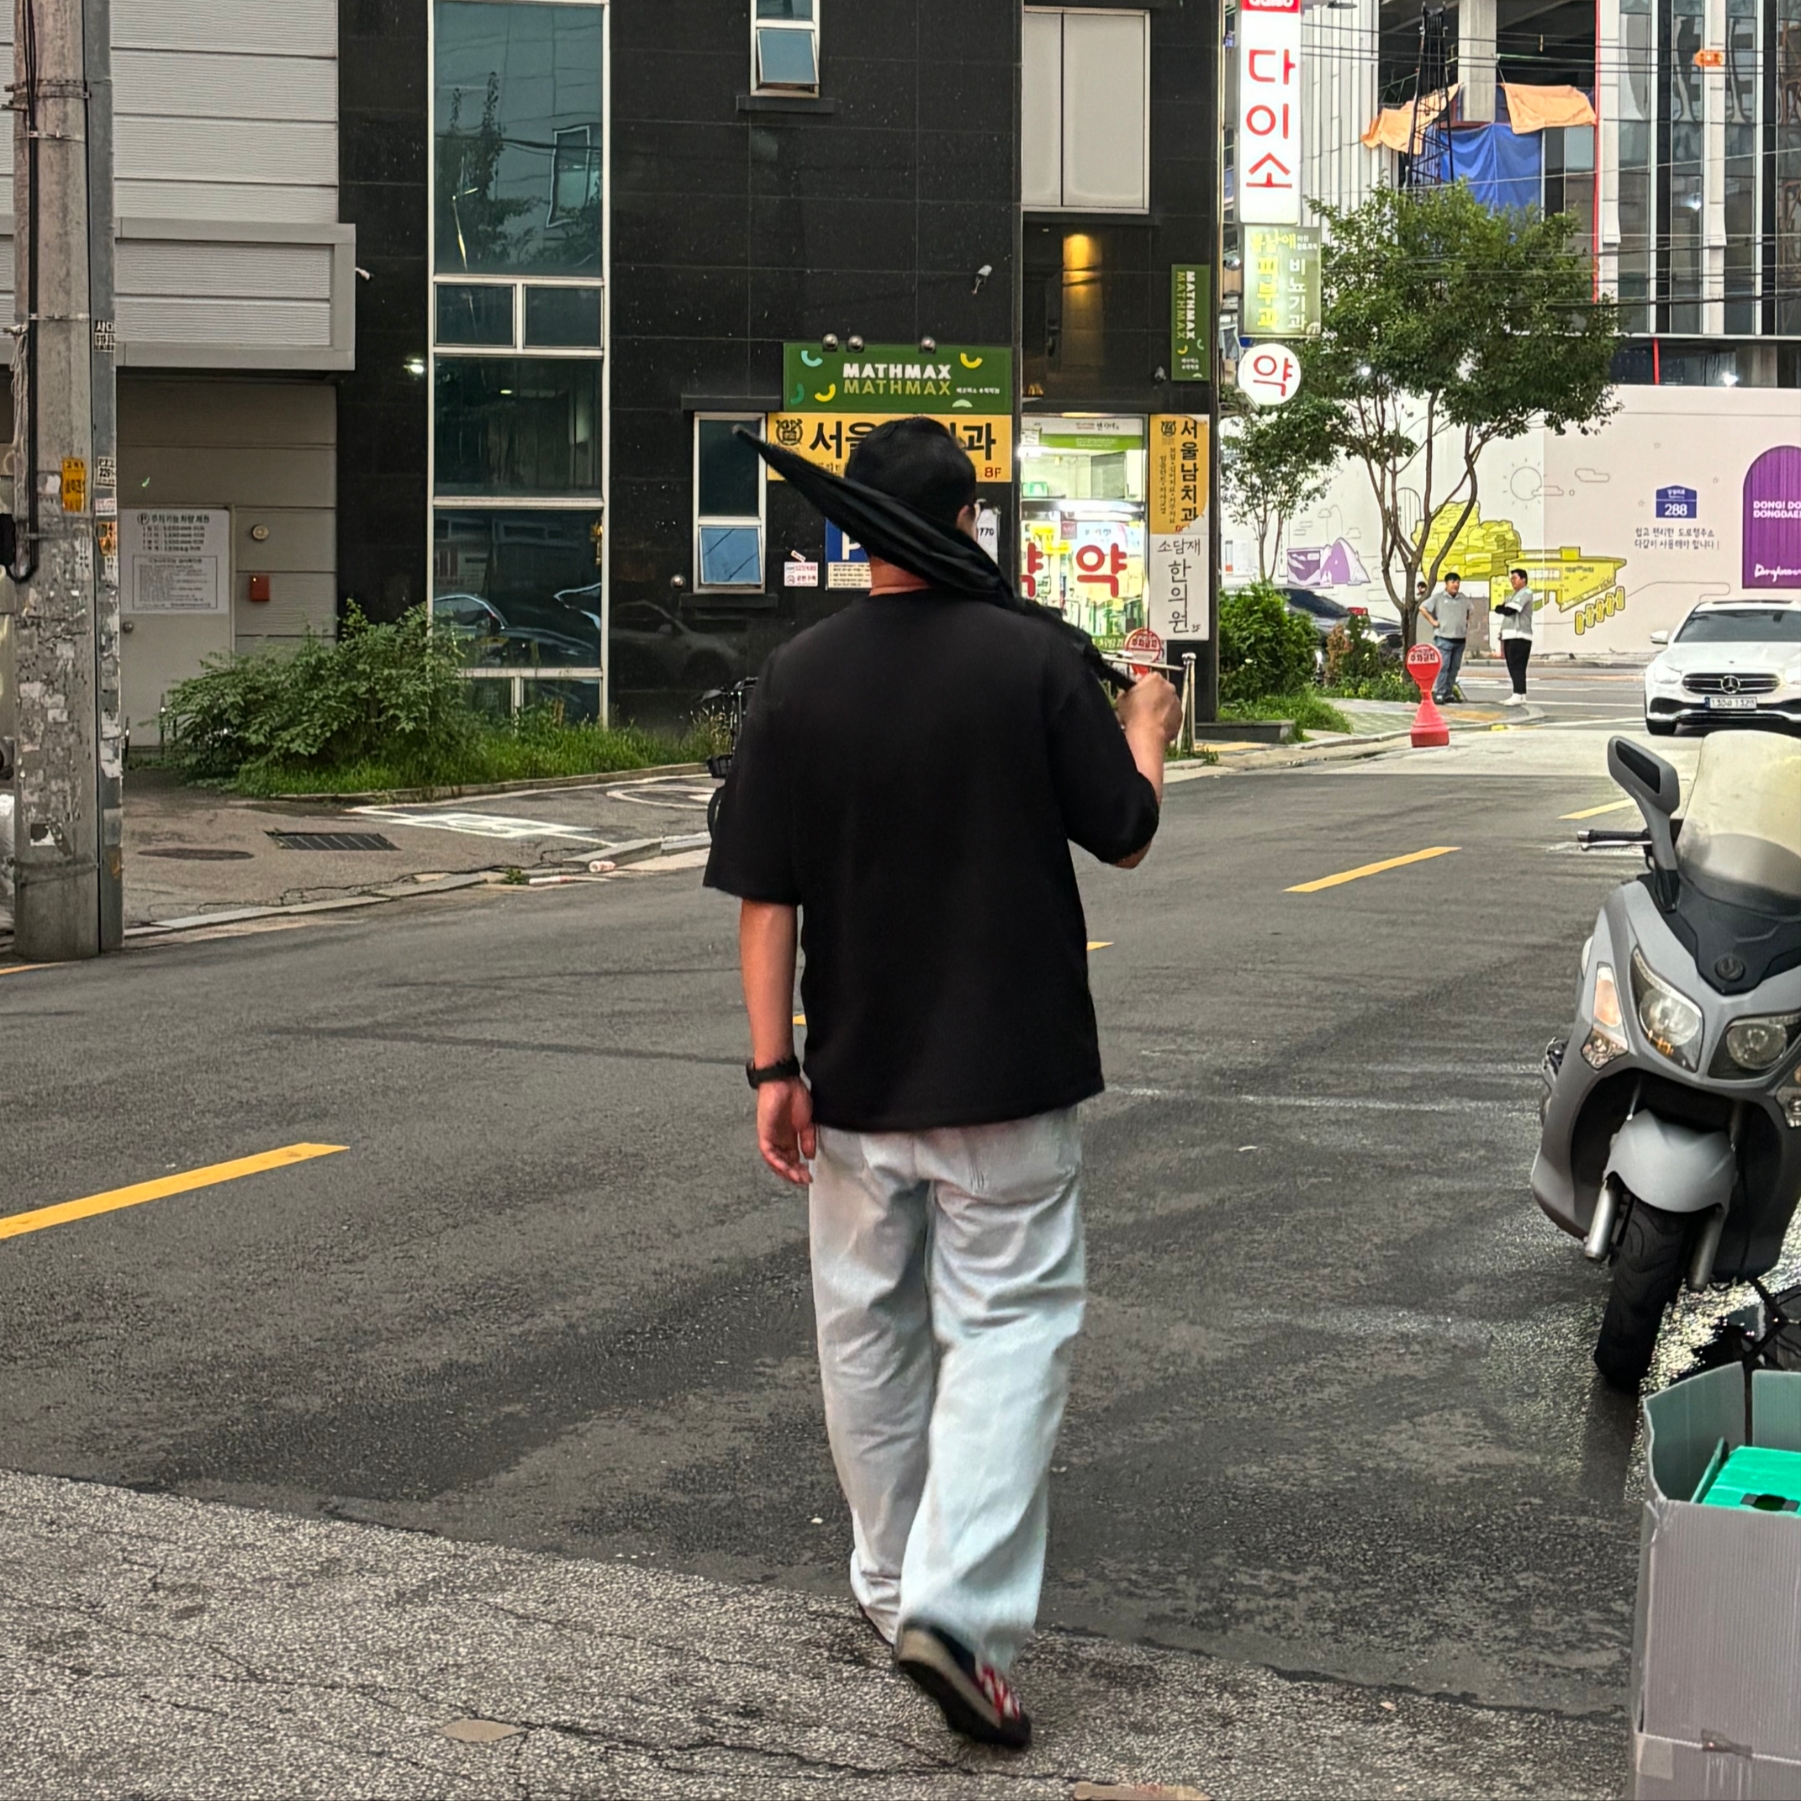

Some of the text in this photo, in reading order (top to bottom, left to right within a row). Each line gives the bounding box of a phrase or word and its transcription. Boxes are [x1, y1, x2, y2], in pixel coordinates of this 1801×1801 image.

[1246, 48, 1296, 189] 다이소
[1177, 271, 1186, 339] MATHMAX
[1186, 271, 1195, 339] MATHMAX
[1288, 258, 1307, 331] 비뇨기과
[843, 363, 951, 379] MATHMAX
[843, 380, 951, 395] MATHMAX
[1253, 355, 1294, 397] 약
[984, 467, 1002, 479] 8F
[1181, 419, 1199, 522] 서울남치과
[1664, 503, 1688, 517] 288
[1075, 543, 1128, 599] 약
[1157, 538, 1201, 556] 소담재
[1168, 558, 1192, 634] 한의원
